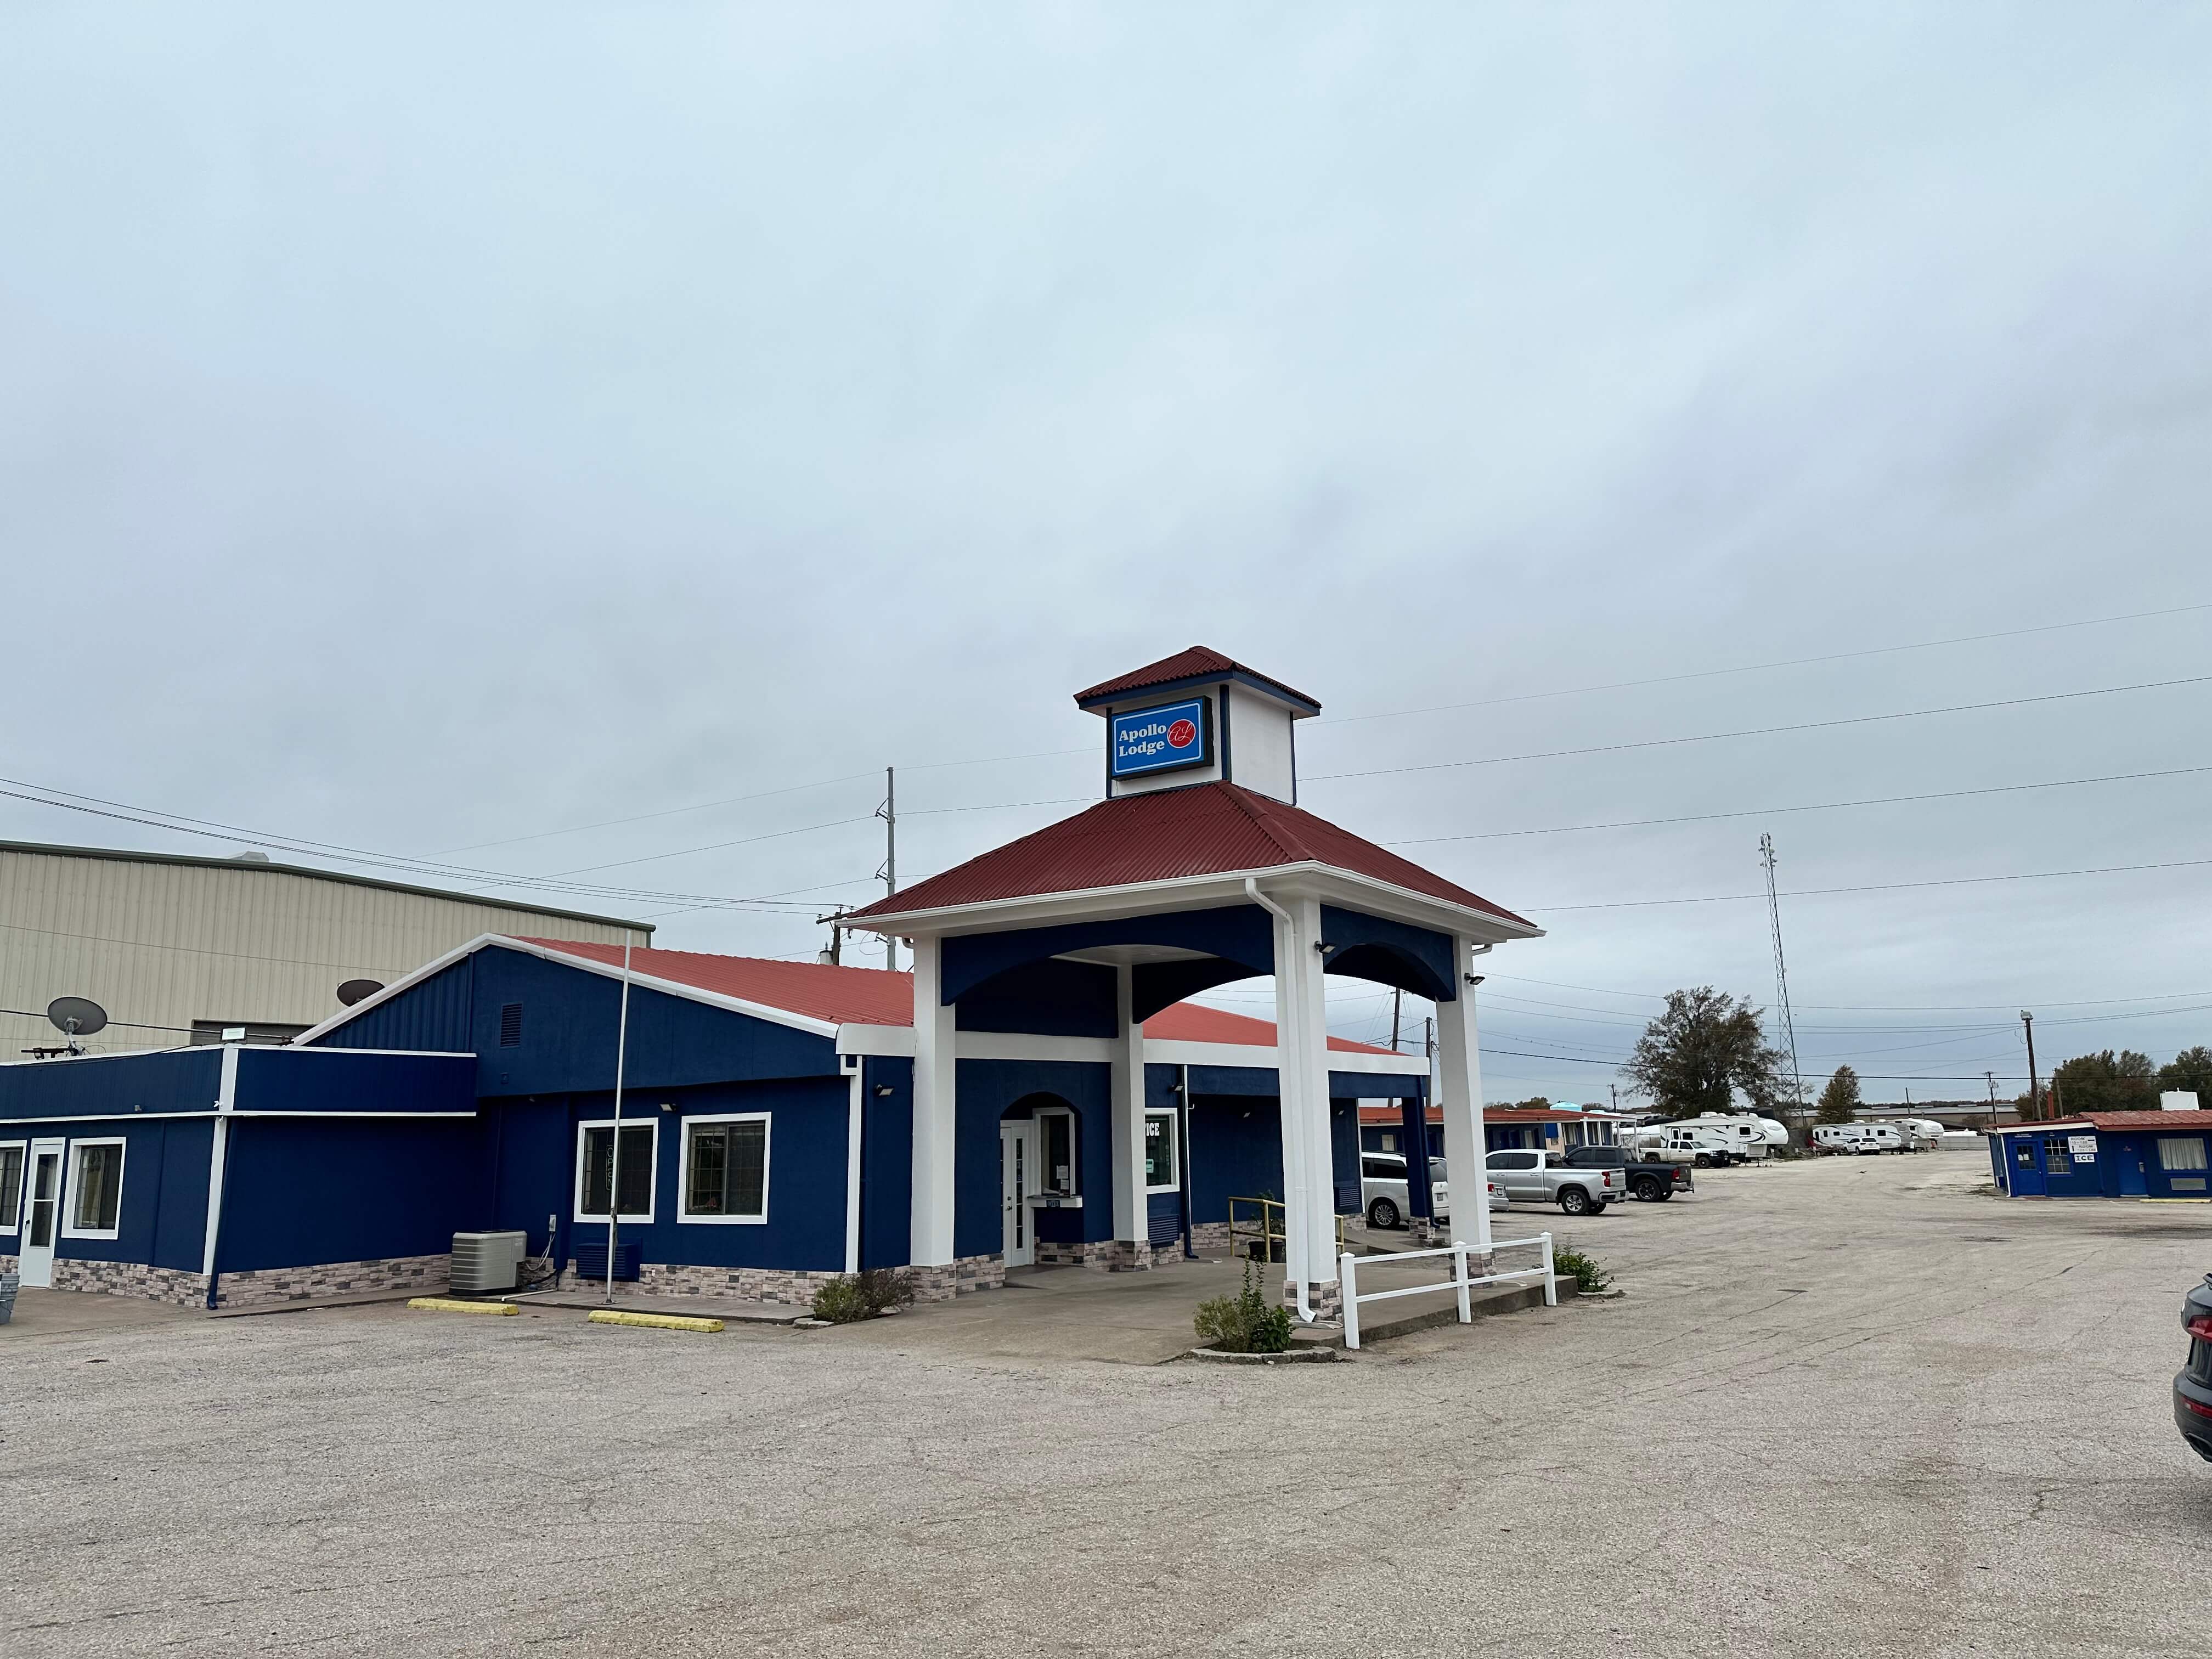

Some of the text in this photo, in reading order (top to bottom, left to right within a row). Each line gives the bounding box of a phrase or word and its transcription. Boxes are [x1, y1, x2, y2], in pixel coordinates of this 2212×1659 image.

[1119, 724, 1166, 743] Apollo
[1119, 741, 1165, 757] Lodge
[1146, 1122, 1160, 1136] ICE
